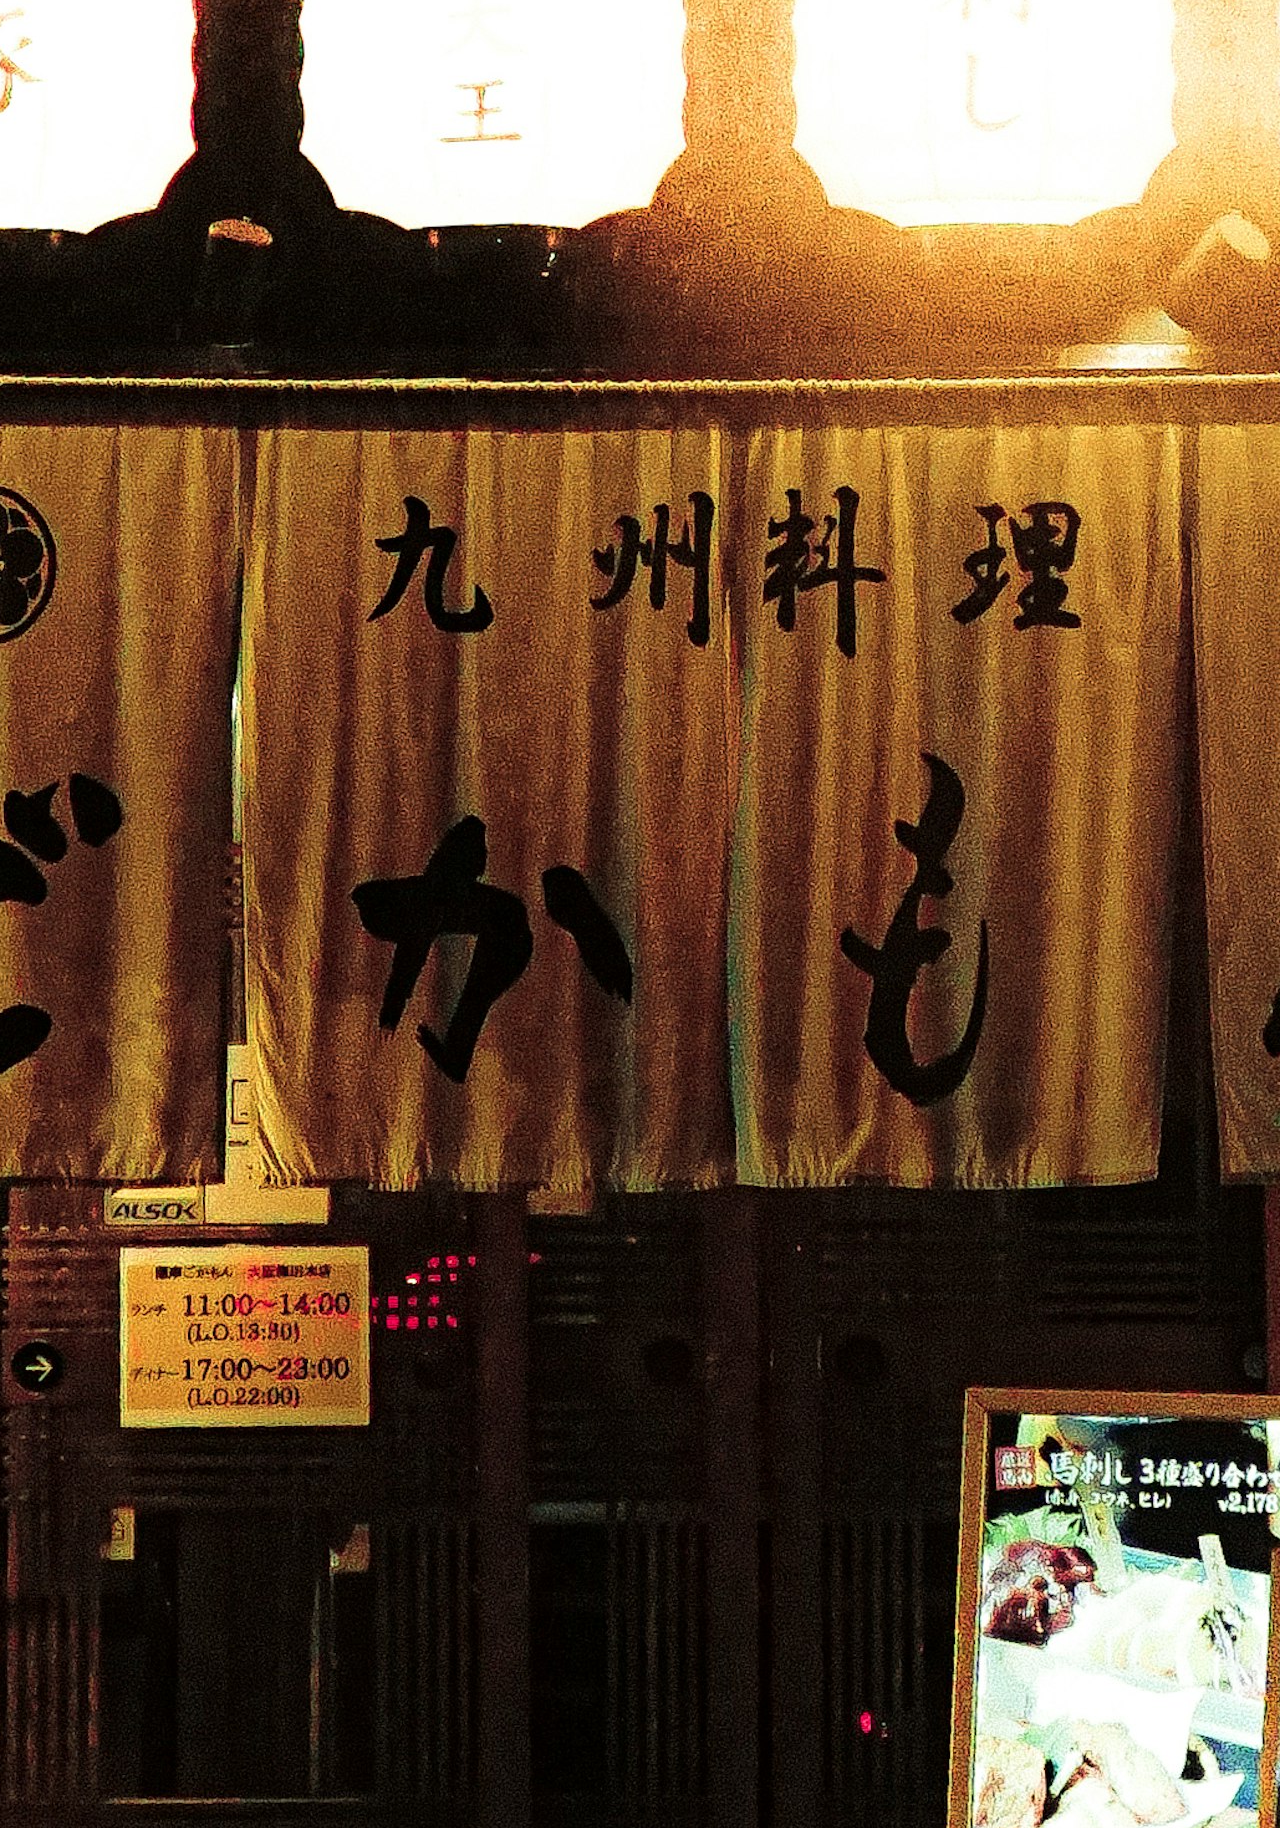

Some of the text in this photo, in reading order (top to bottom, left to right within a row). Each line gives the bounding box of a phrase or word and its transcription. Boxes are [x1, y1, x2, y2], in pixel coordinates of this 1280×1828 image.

[368, 489, 1082, 658] 九州料理
[112, 1202, 198, 1221] ALSOK
[1048, 1452, 1133, 1487] 馬刺し
